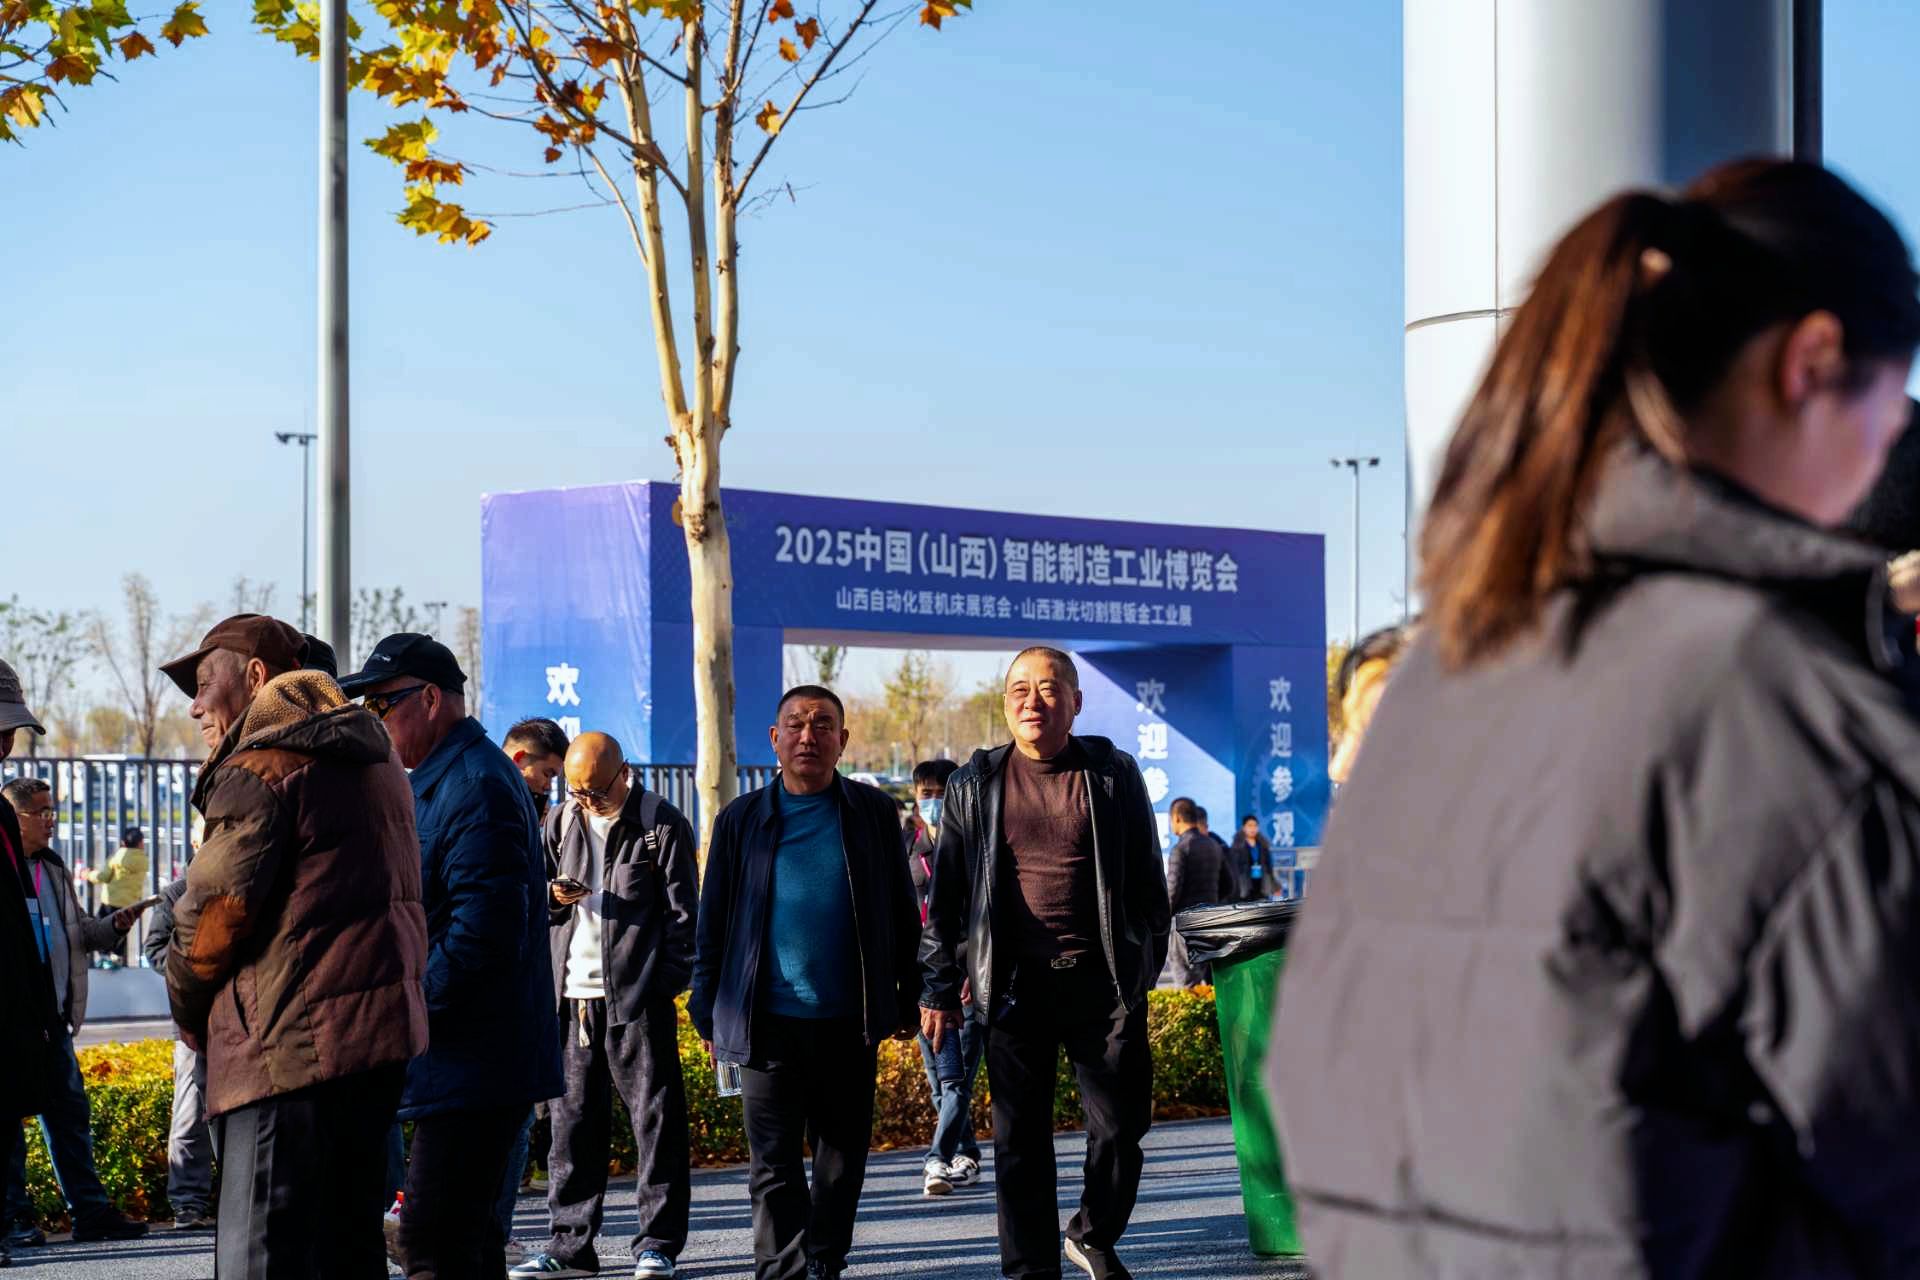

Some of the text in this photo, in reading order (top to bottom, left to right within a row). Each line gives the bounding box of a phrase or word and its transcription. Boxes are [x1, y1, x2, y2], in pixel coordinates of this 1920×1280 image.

[775, 525, 1239, 593] 2025中国(山西)智能制造工业博览会
[1269, 676, 1295, 848] 欢迎参观
